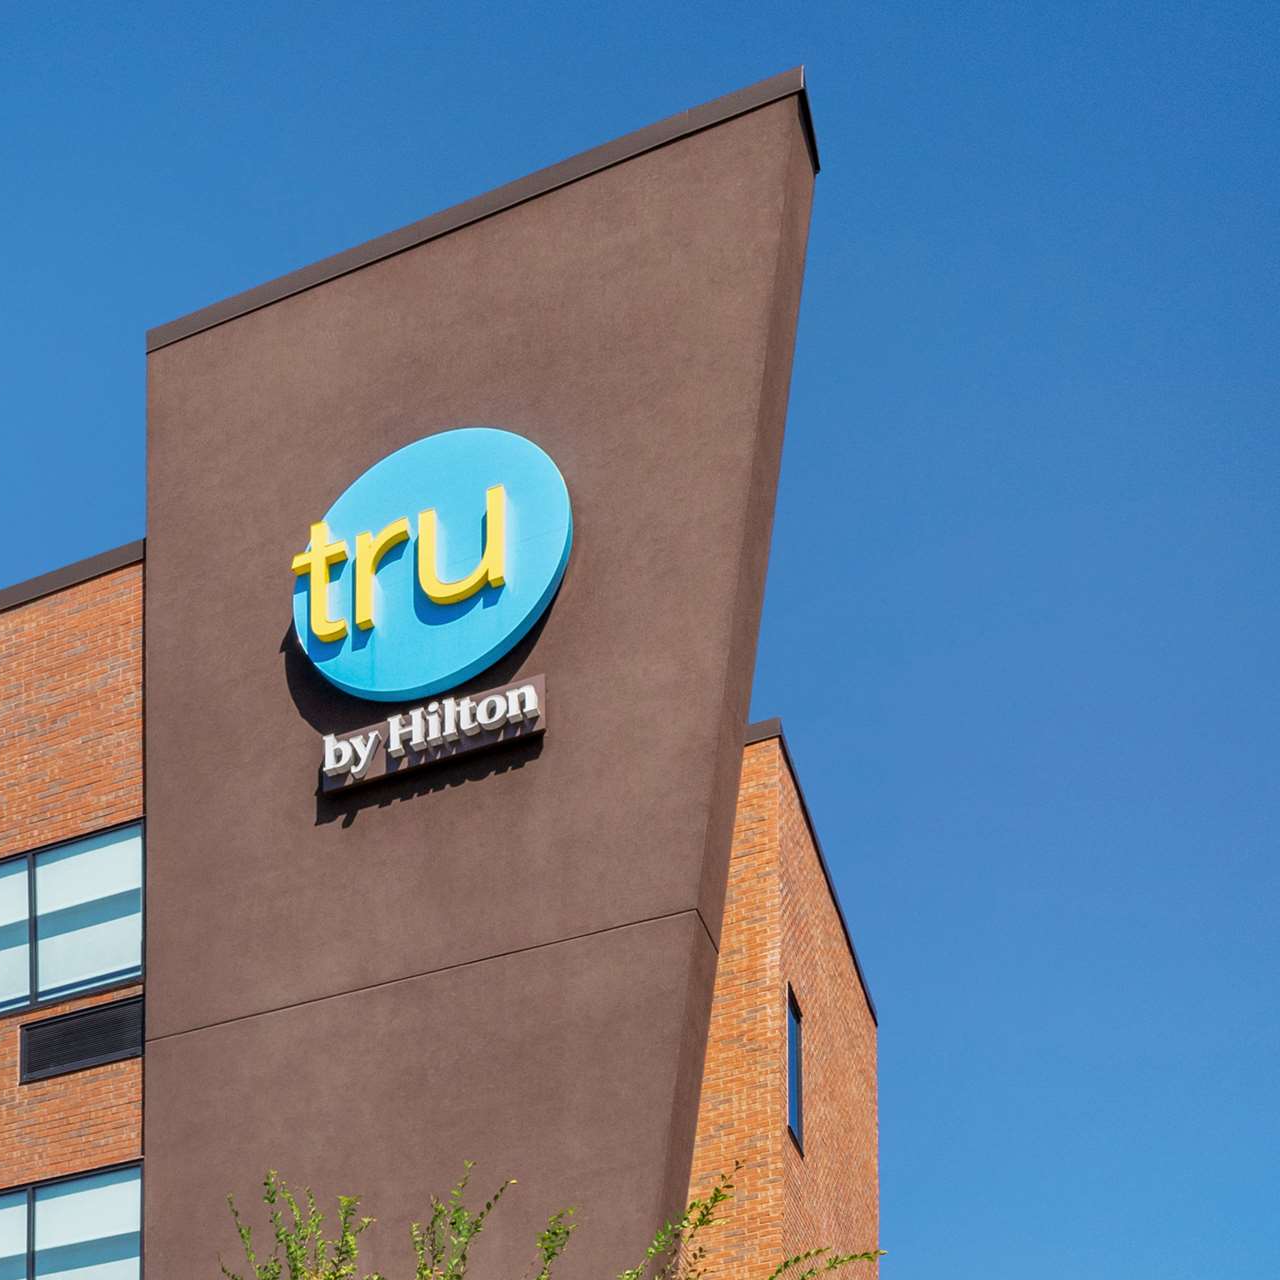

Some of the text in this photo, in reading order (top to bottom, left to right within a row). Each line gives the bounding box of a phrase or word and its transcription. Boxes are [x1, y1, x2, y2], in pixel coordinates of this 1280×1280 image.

[291, 484, 506, 643] tru
[322, 683, 541, 779] by Hilton
